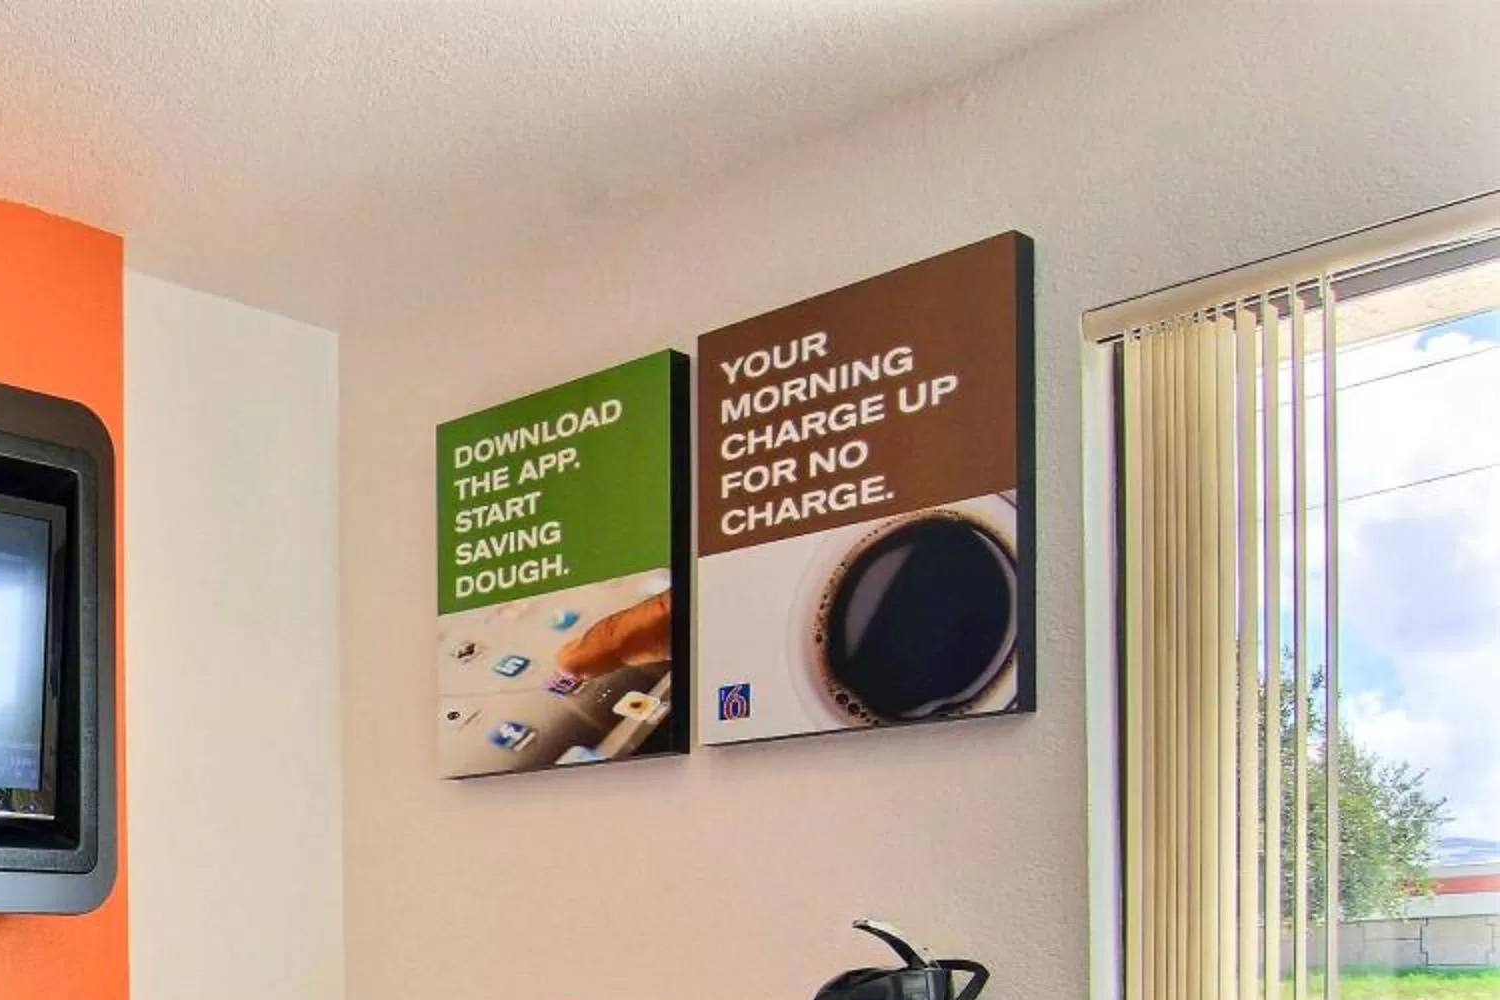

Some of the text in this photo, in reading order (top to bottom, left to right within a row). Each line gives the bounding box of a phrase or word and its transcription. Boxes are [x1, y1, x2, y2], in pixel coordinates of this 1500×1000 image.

[719, 330, 829, 386] YOUR
[720, 345, 915, 425] MORNING
[454, 398, 623, 469] DOWNLOAD
[720, 374, 959, 461] CHARGE UP
[454, 447, 581, 501] THE APP.
[720, 439, 869, 499] FOR NO
[454, 491, 542, 534] START
[720, 474, 896, 537] CHARGE.
[455, 522, 562, 566] SAVING
[455, 562, 571, 599] DOUGH.
